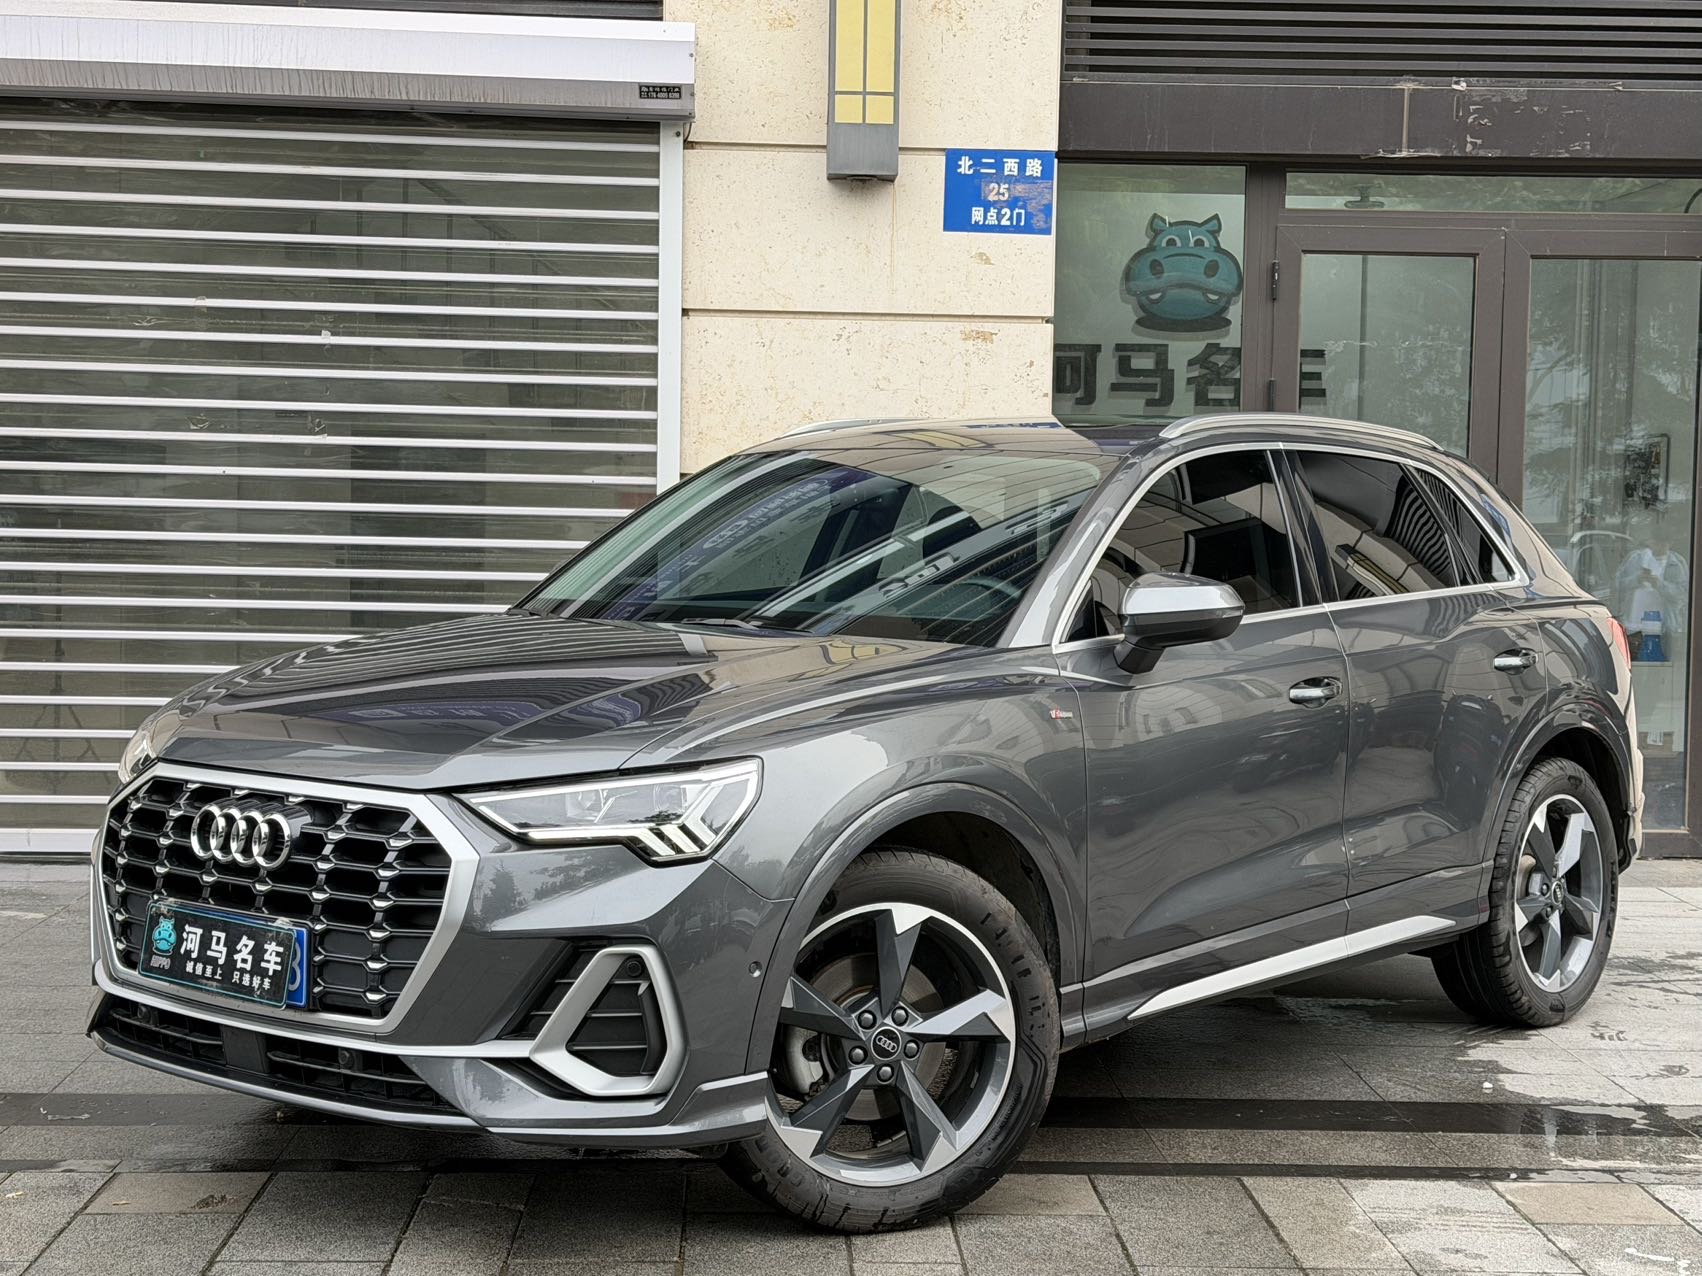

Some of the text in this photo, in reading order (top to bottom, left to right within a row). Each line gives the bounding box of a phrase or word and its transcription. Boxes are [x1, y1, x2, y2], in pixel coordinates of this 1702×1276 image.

[957, 156, 1043, 177] 北二西路
[988, 183, 1009, 201] 25
[971, 207, 1025, 226] 网点2门
[180, 923, 284, 977] 河马名车
[185, 960, 272, 991] 诚信至上 只选好车
